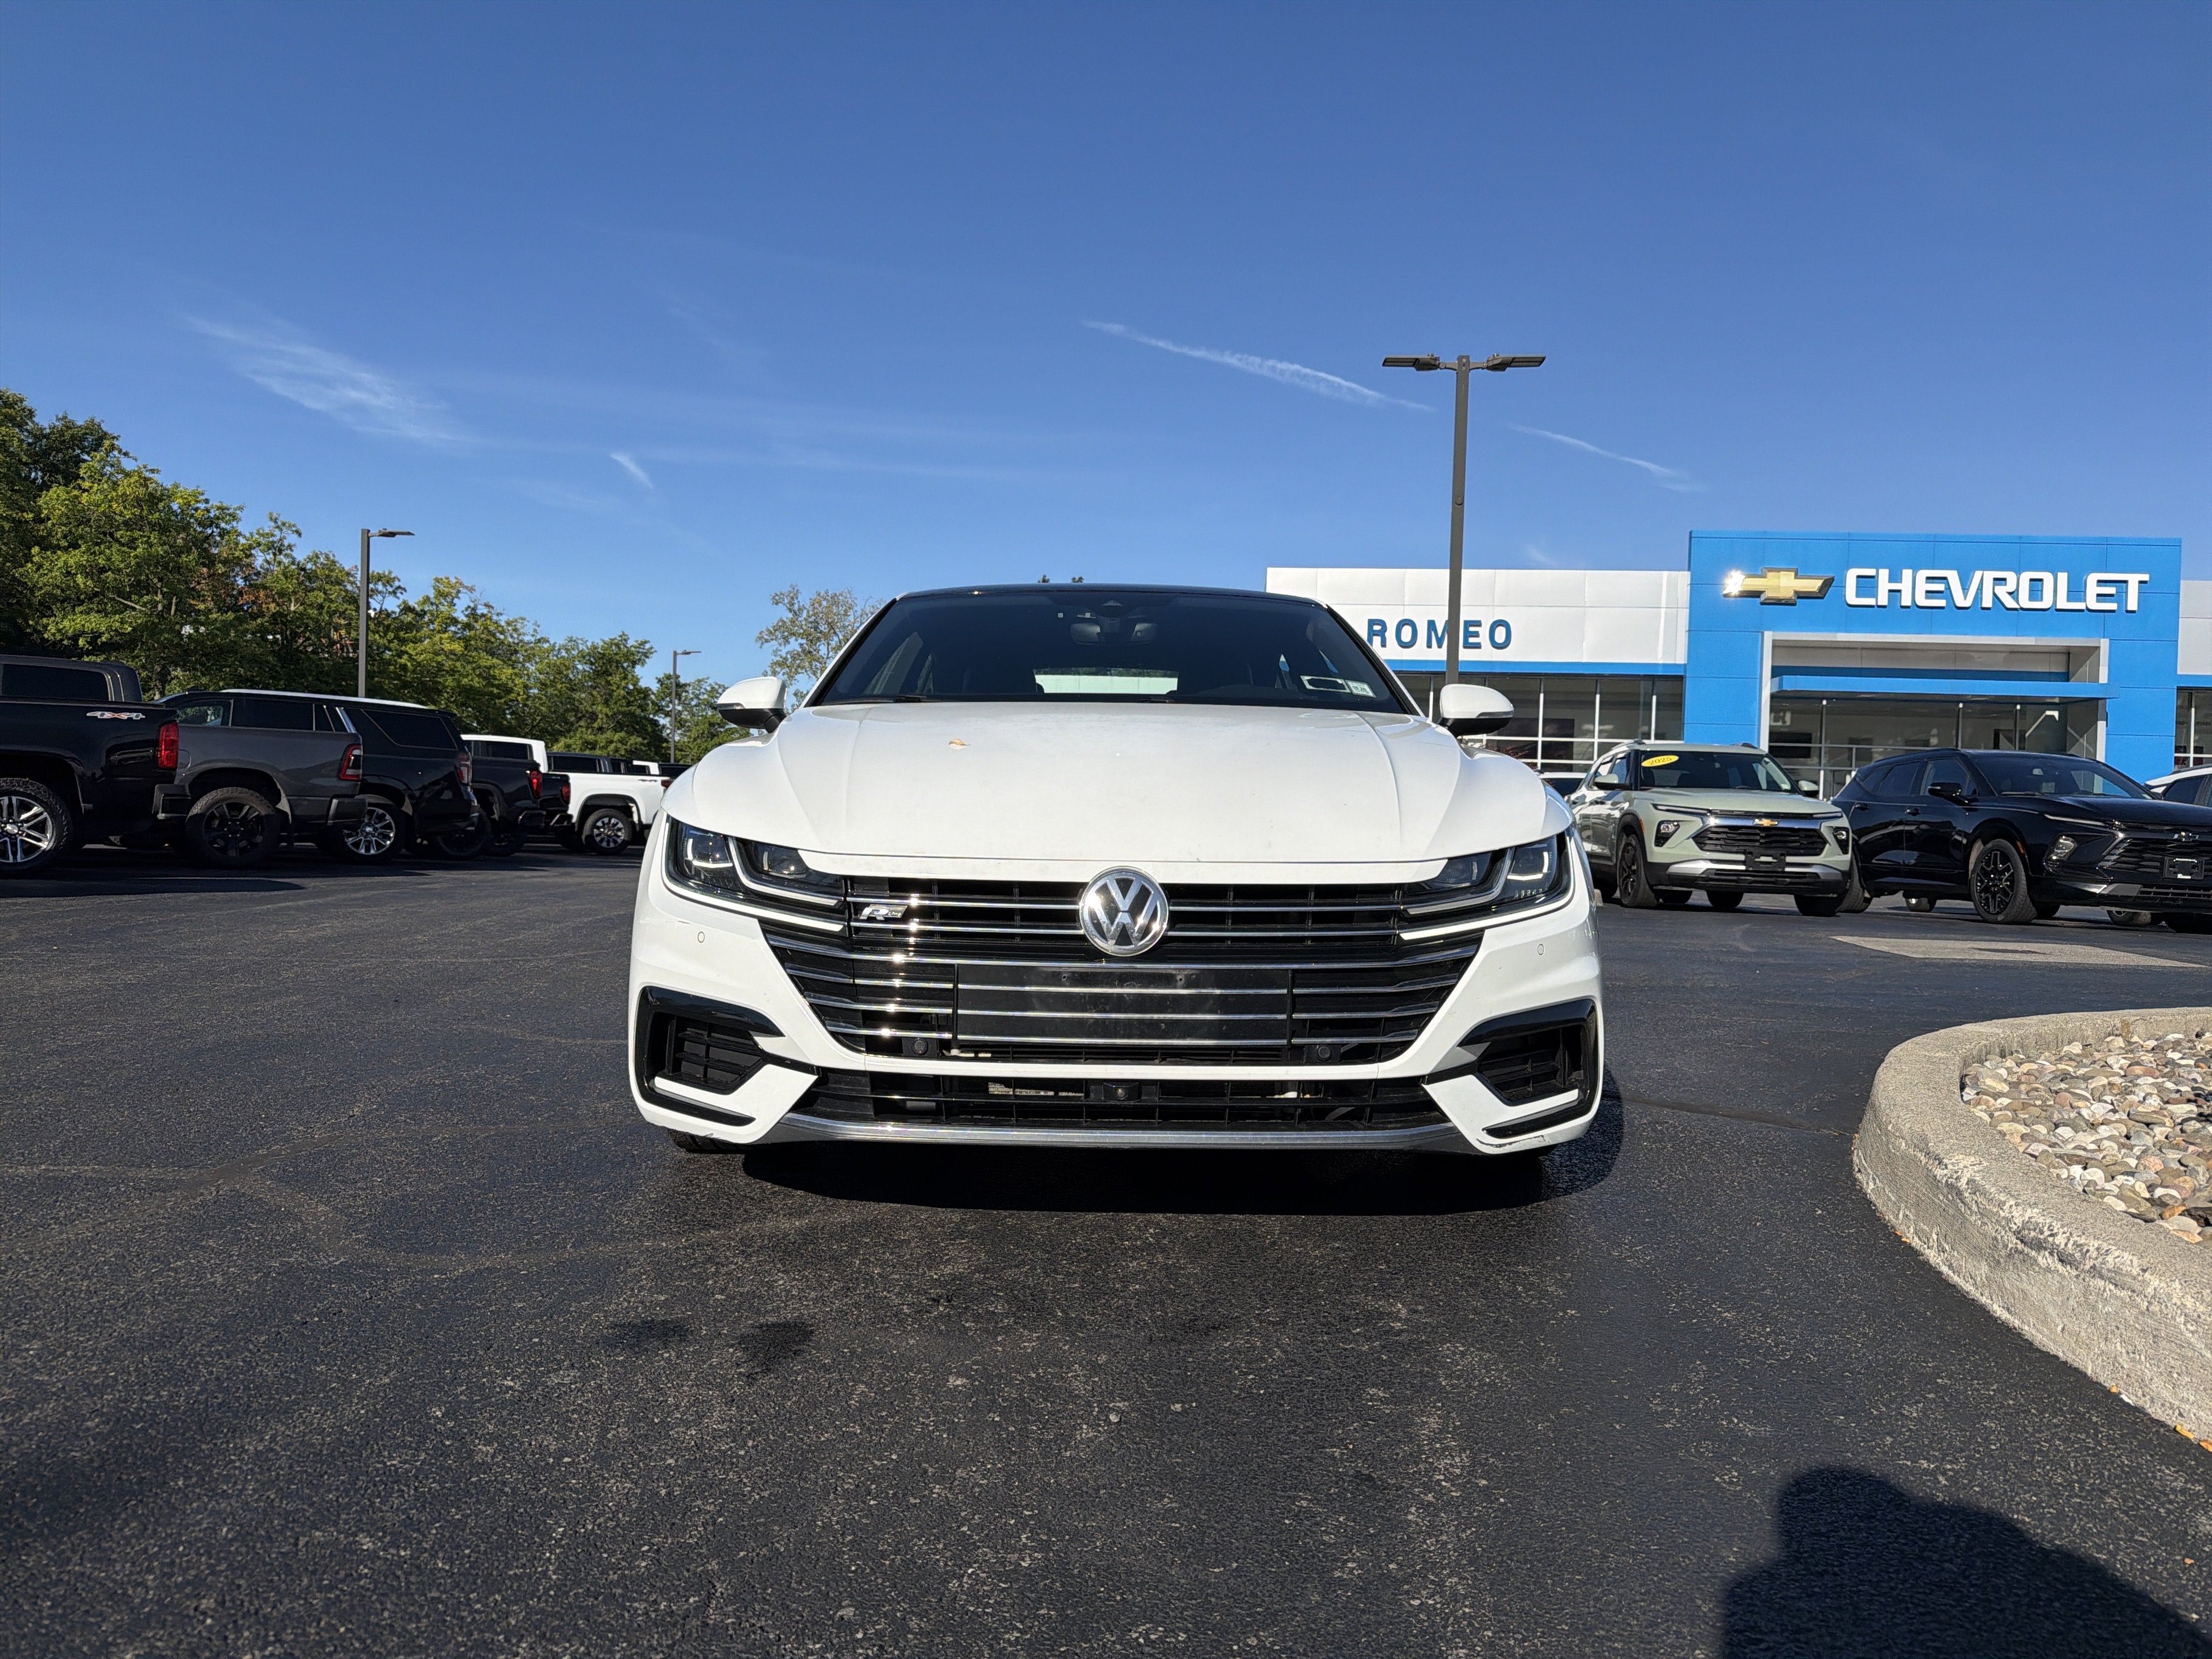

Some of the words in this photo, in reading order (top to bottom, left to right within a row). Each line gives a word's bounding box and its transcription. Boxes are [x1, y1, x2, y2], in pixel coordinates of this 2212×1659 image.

[1845, 568, 2149, 612] CHEVROLET
[1367, 618, 1512, 650] ROMEO
[1649, 757, 1672, 765] 2025
